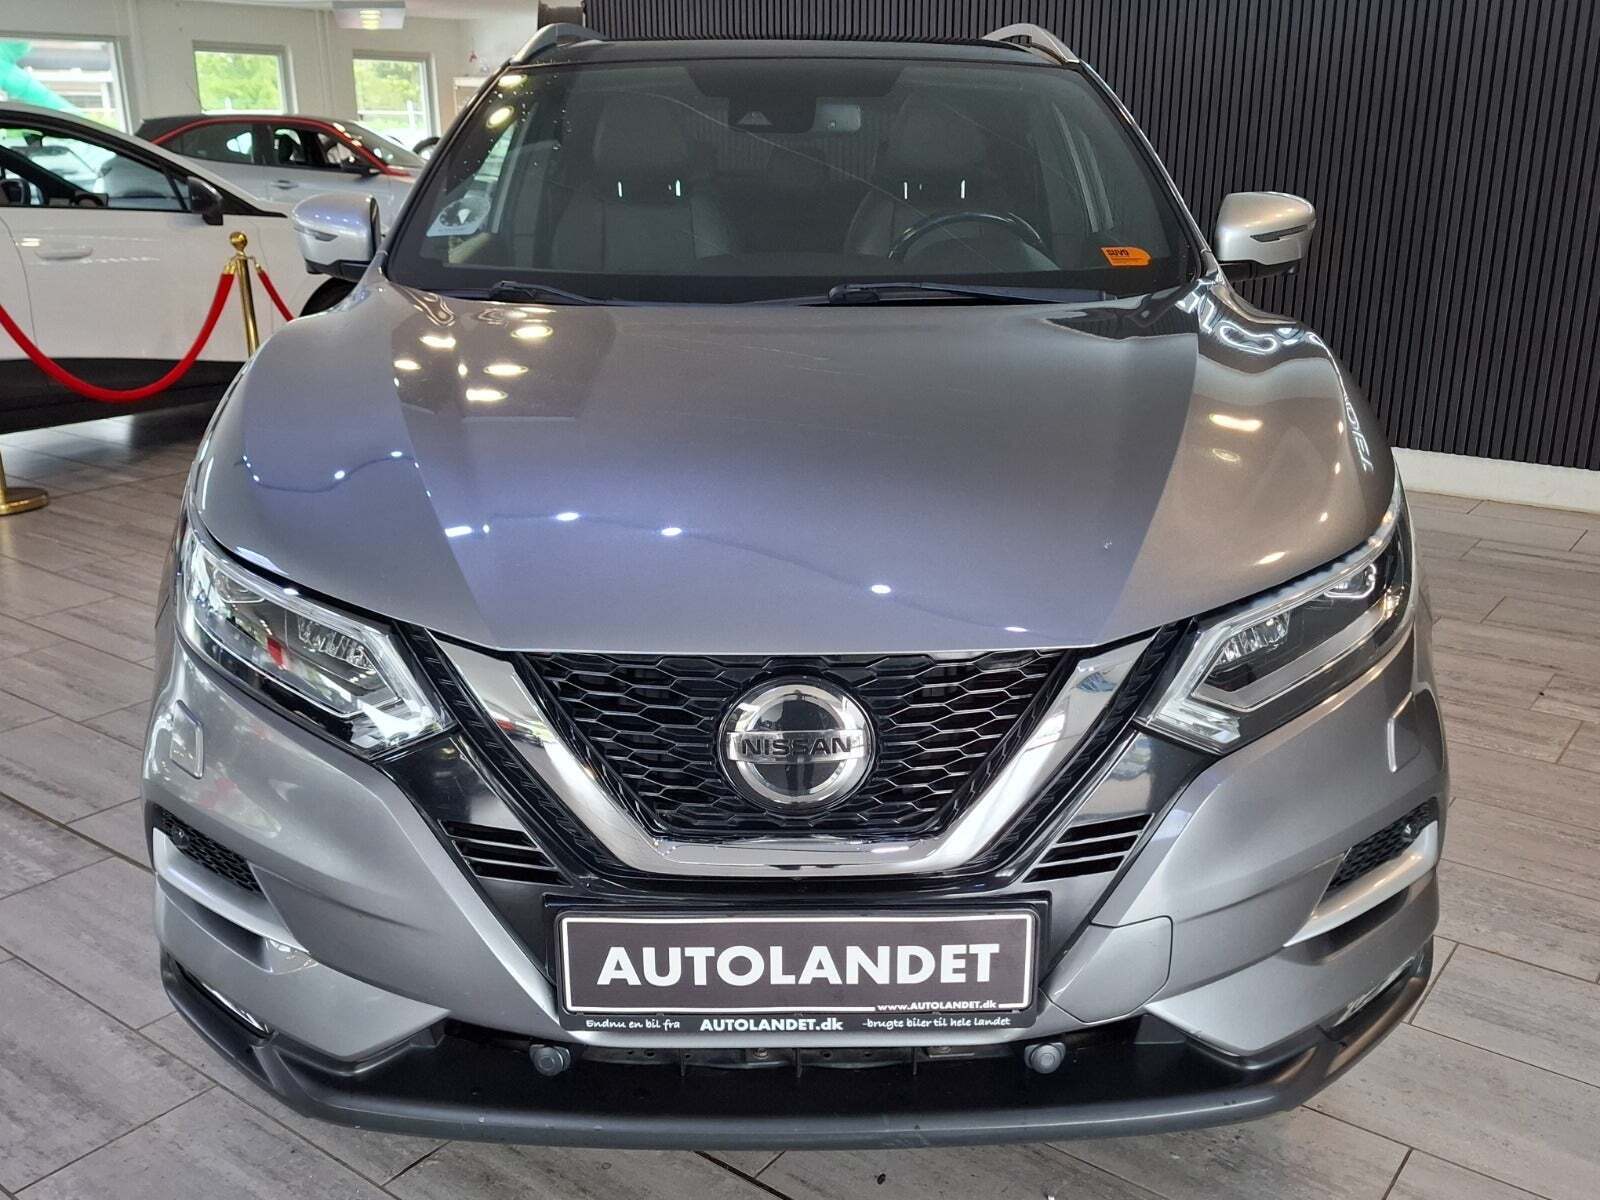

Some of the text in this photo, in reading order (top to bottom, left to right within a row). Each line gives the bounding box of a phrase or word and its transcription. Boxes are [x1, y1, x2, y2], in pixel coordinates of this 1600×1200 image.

[741, 738, 852, 756] NISSAN
[596, 943, 1000, 987] AUTOLANDET
[877, 1000, 997, 1011] www.AUTOLANDET.dk
[586, 1019, 626, 1028] Endnu
[645, 1019, 661, 1028] bil
[663, 1019, 680, 1031] fra
[700, 1018, 844, 1031] AUTOLANDET.dk
[906, 1018, 932, 1027] biler
[933, 1017, 947, 1027] til
[950, 1017, 971, 1026] hele
[974, 1017, 1011, 1026] landet
